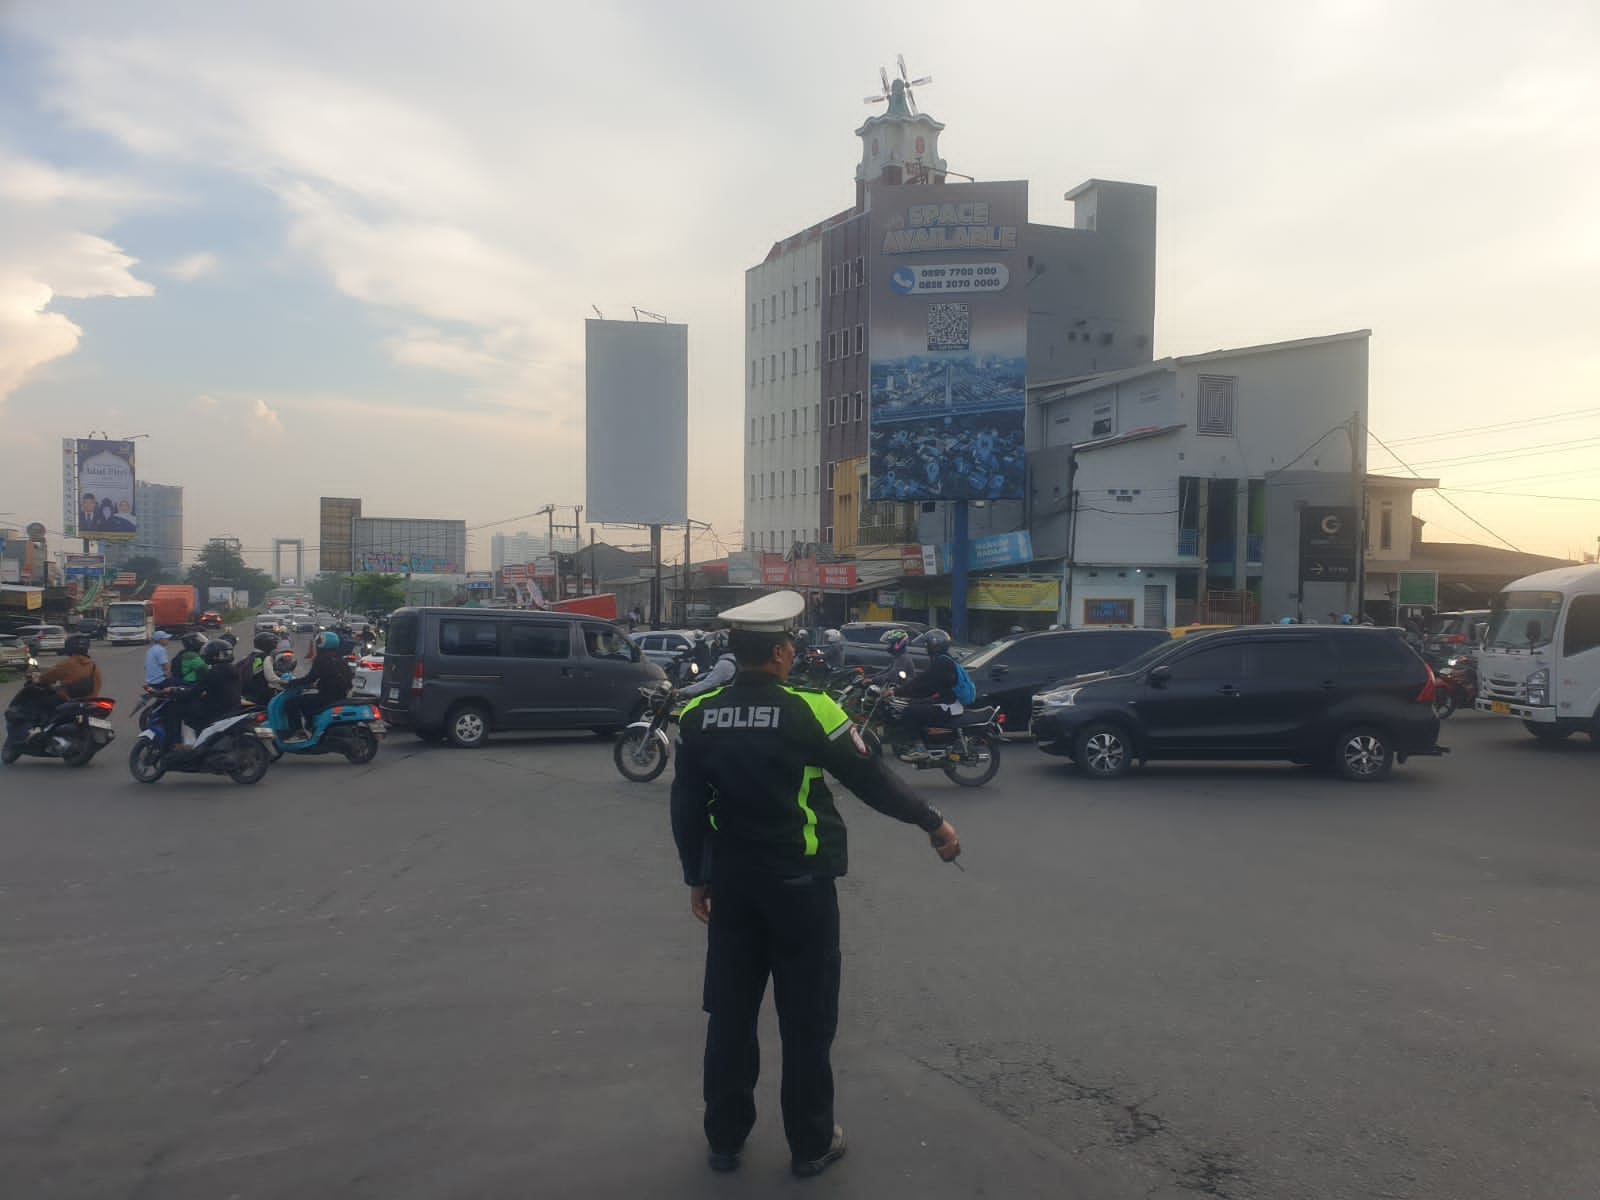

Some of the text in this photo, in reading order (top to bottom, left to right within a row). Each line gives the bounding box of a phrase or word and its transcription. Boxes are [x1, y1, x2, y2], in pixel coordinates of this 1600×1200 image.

[909, 202, 988, 226] SPACE
[882, 225, 1017, 254] AVAILABLE
[702, 706, 781, 729] POLISI
